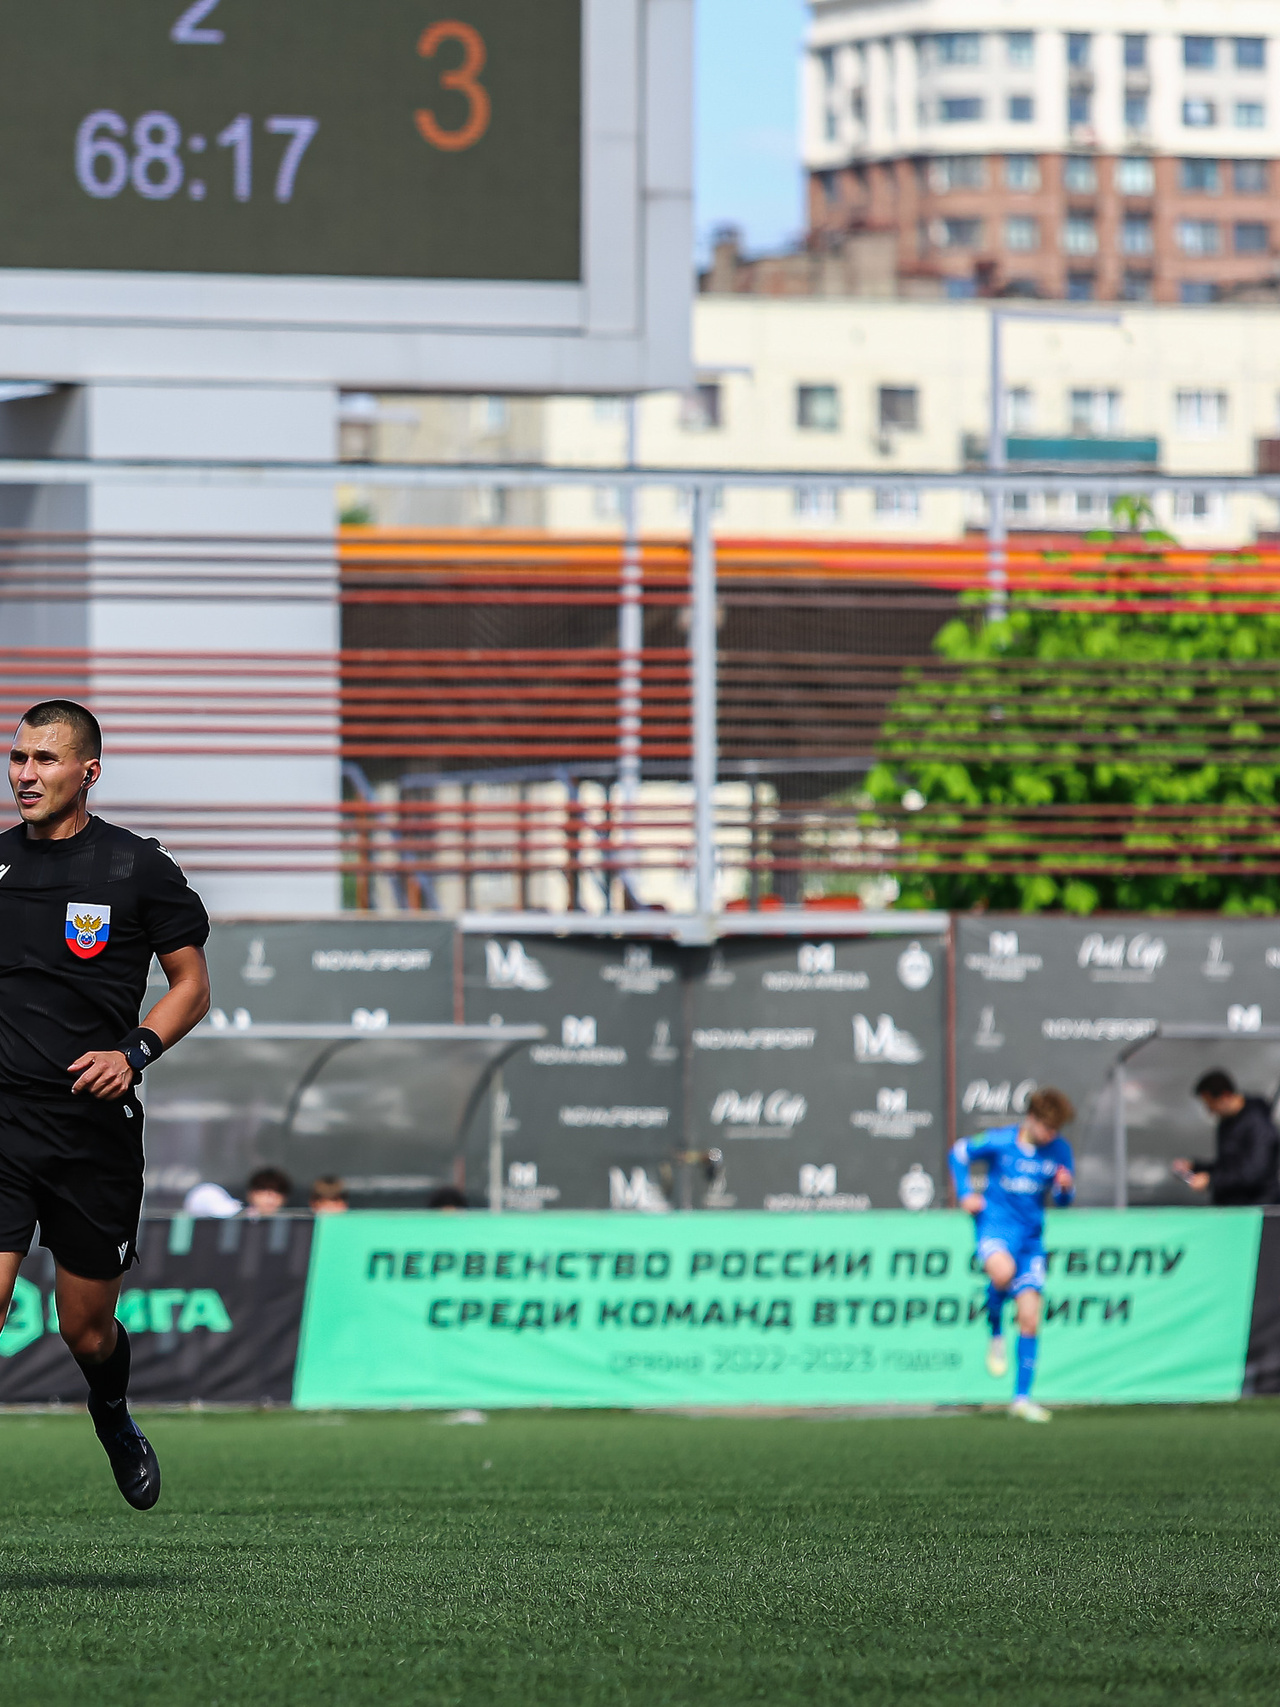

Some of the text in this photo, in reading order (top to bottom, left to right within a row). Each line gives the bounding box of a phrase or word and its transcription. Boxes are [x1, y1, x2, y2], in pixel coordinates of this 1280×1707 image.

[414, 20, 491, 152] 3
[75, 109, 319, 201] 68:17
[367, 1250, 671, 1281] ПЕРВЕНСТВО
[689, 1250, 872, 1279] РОССИИ
[890, 1249, 950, 1278] ПО
[428, 1299, 579, 1332] СРЕДИ
[598, 1299, 792, 1331] КОМАНД
[1013, 1297, 1131, 1324] ИГИ
